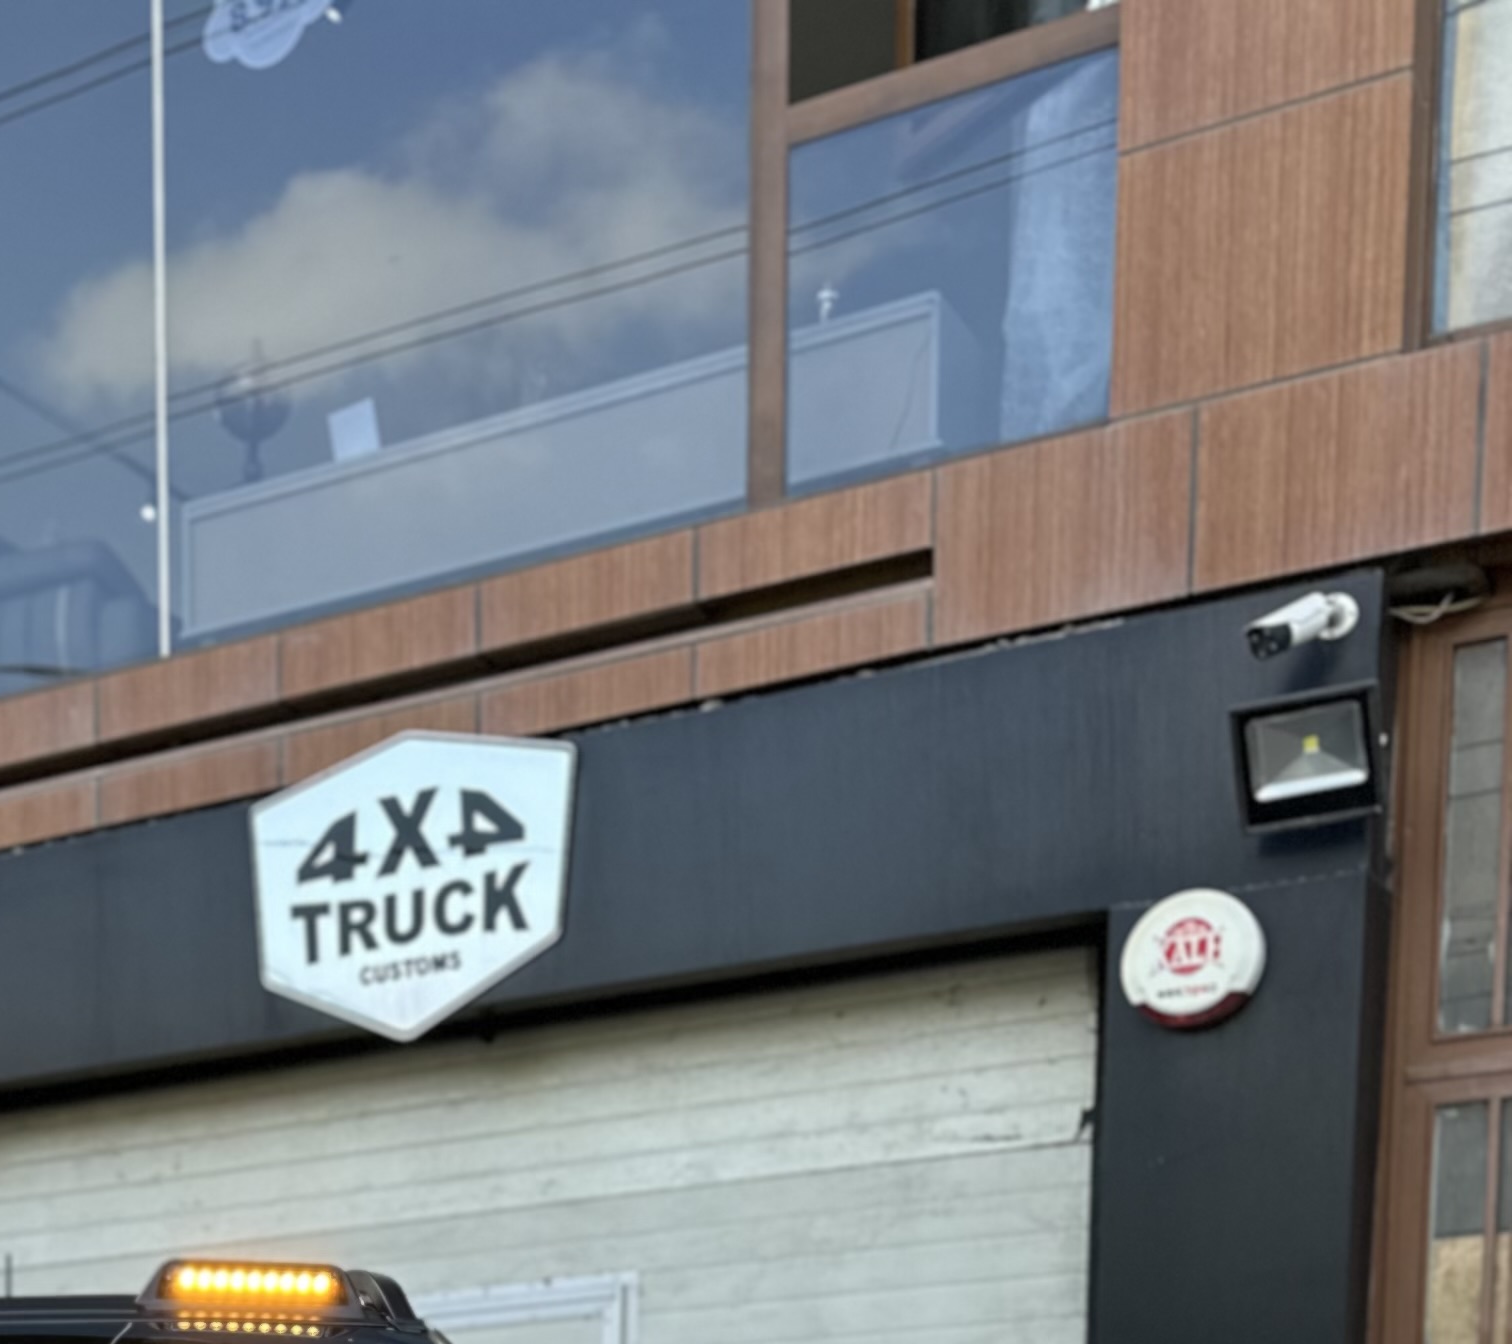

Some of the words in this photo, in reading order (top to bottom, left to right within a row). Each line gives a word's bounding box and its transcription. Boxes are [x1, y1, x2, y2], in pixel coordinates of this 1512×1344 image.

[297, 787, 525, 886] 4X4
[290, 860, 530, 965] TRUCK
[359, 951, 461, 986] CUSTOMS
